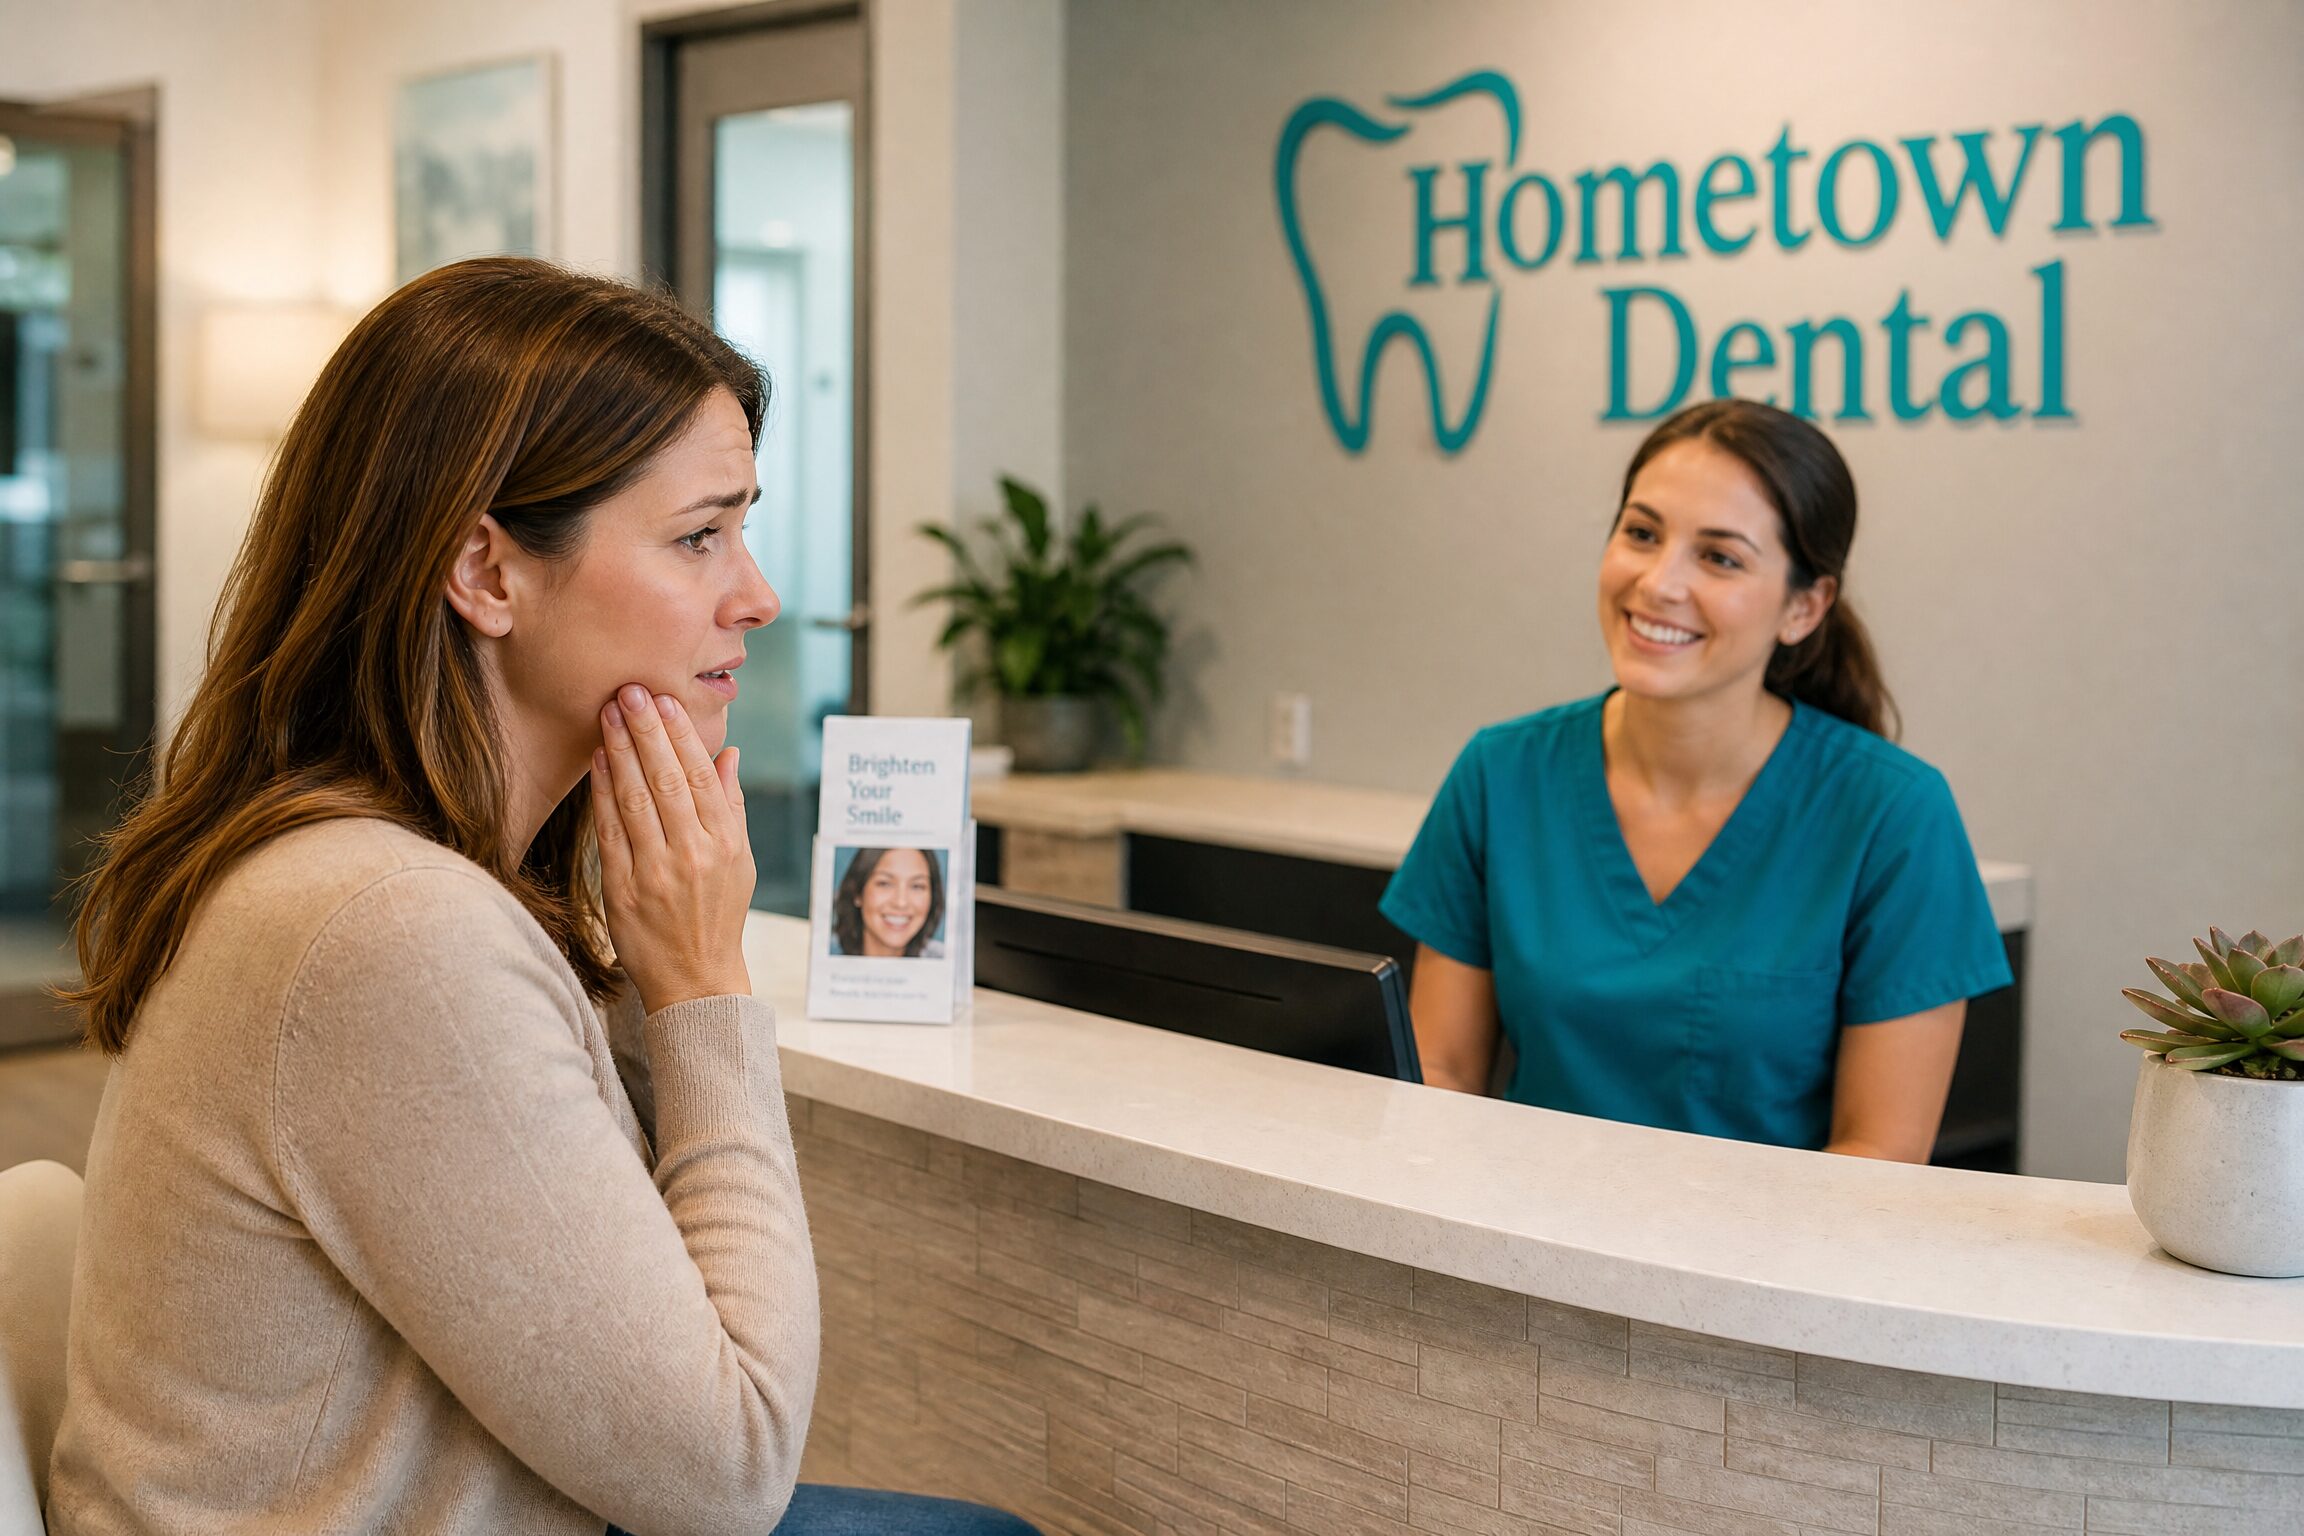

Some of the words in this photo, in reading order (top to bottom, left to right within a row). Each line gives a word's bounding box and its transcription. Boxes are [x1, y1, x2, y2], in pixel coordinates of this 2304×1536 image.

[1409, 113, 2157, 287] Hometown
[1600, 260, 2078, 422] Dental
[848, 753, 936, 779] Brighten
[847, 779, 892, 799] Your
[847, 804, 903, 825] Smile
